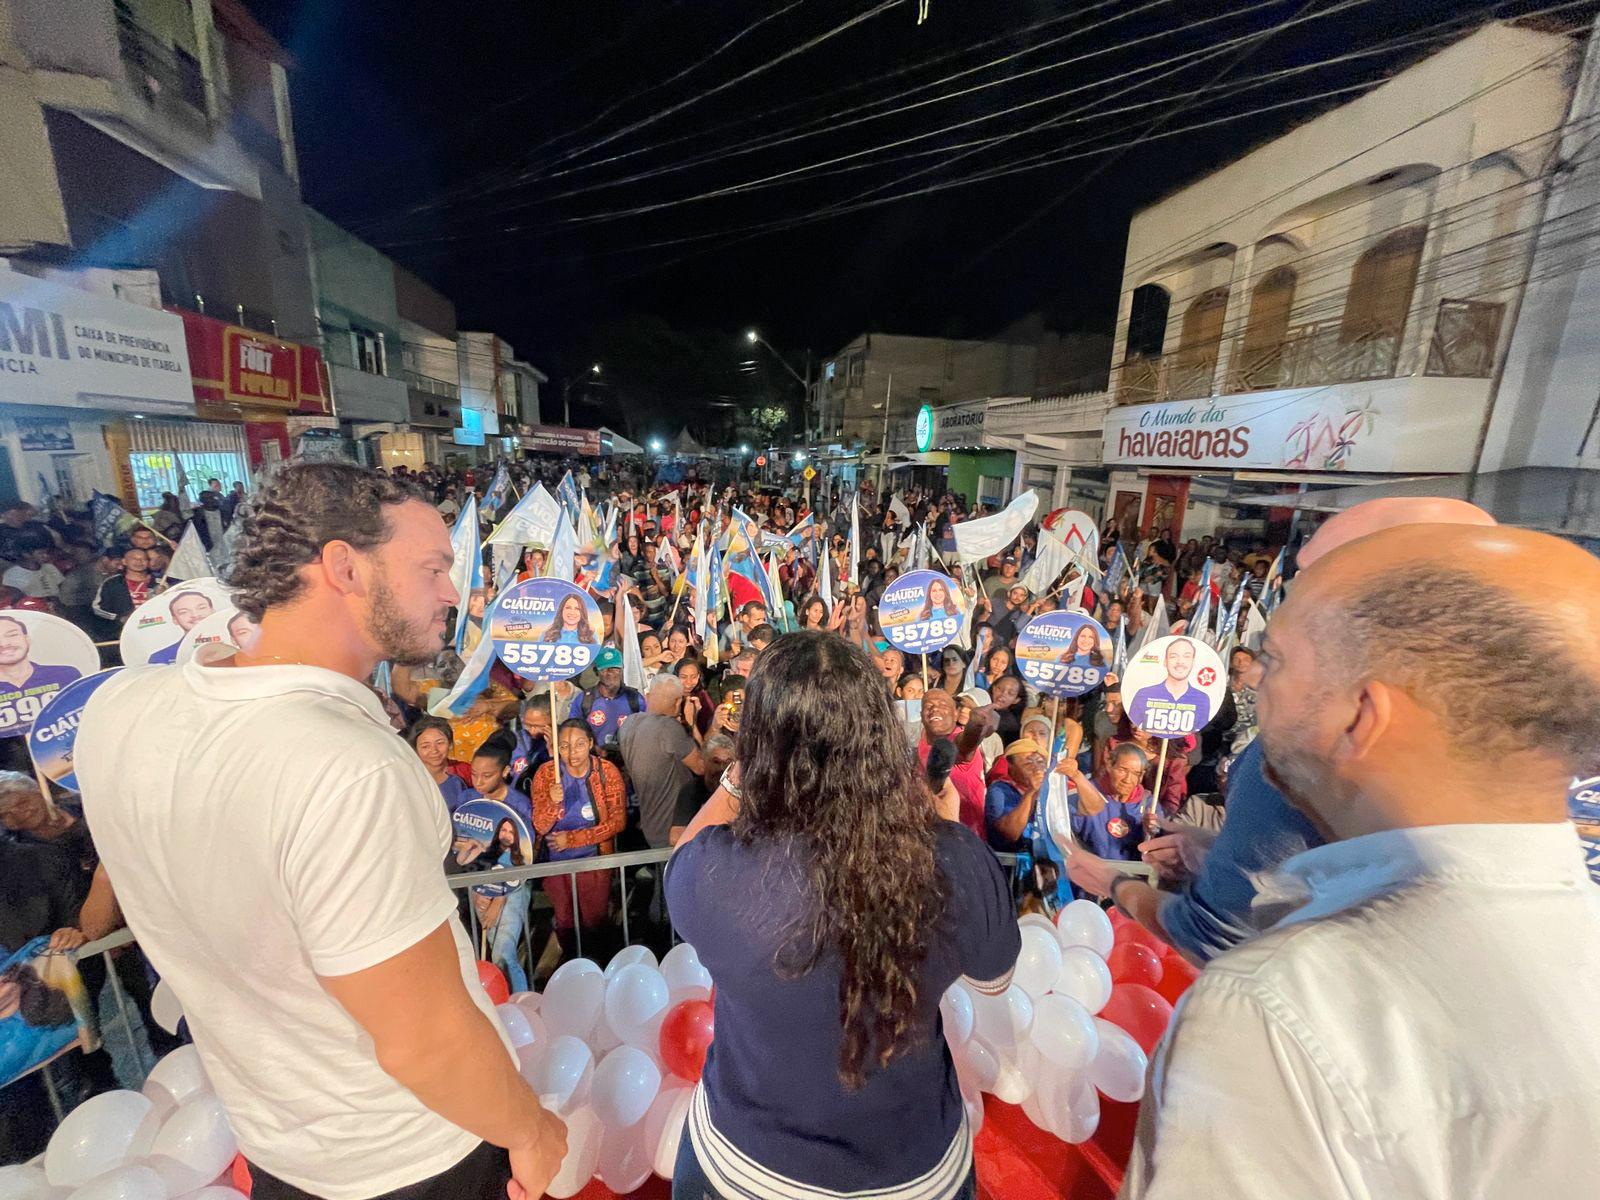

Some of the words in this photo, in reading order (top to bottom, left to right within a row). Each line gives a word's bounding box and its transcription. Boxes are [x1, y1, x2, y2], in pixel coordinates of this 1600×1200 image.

[74, 325, 104, 341] CAIXA
[105, 331, 118, 344] DE
[78, 345, 92, 359] DO
[140, 356, 153, 368] DE
[153, 358, 182, 373] ITABELA
[1140, 410, 1151, 428] O
[1151, 406, 1197, 427] Mundo
[1200, 404, 1228, 424] das
[1118, 425, 1251, 460] havaianas
[891, 618, 958, 643] 55789
[502, 642, 591, 667] 55789
[1024, 660, 1100, 686] 55789
[1145, 708, 1195, 732] 1590
[453, 812, 494, 832] CLÁUDIA
